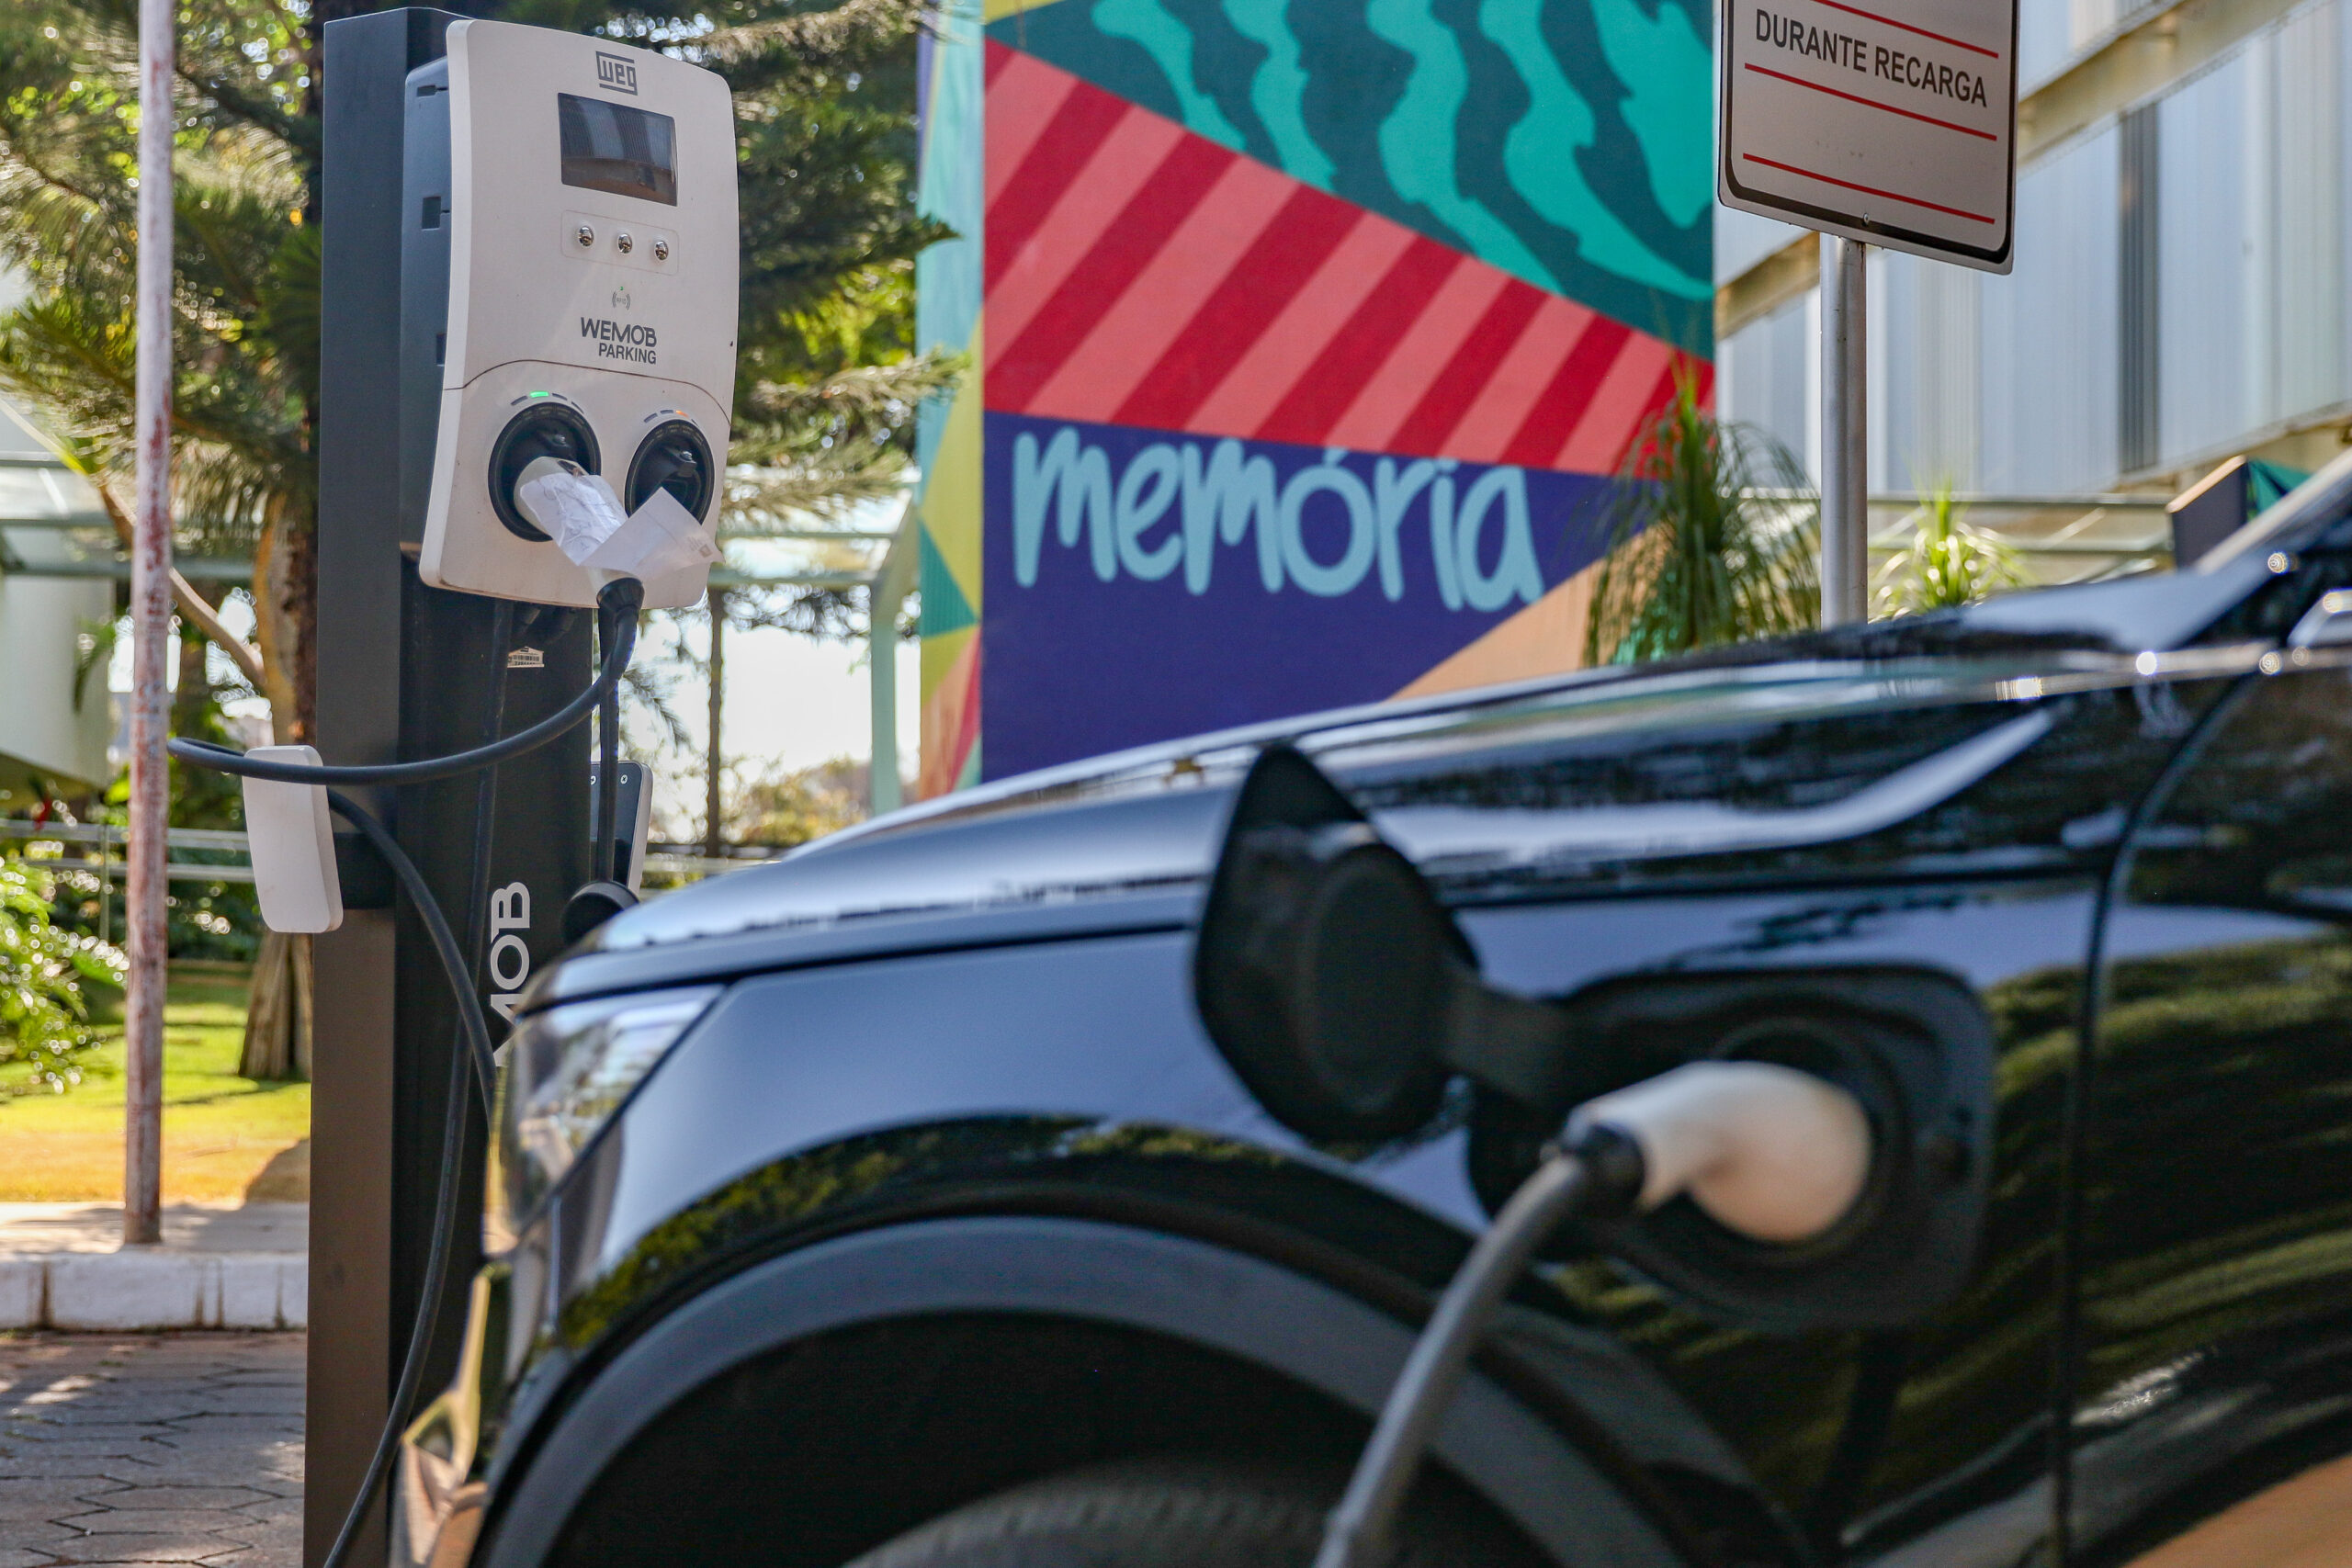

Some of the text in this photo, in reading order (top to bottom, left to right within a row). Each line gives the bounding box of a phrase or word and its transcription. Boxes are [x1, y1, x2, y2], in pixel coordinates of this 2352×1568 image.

[1756, 8, 1987, 107] DURANTE RECARGA
[581, 316, 657, 348] WEMOB
[598, 342, 657, 365] PARKING
[1013, 427, 1544, 612] memória
